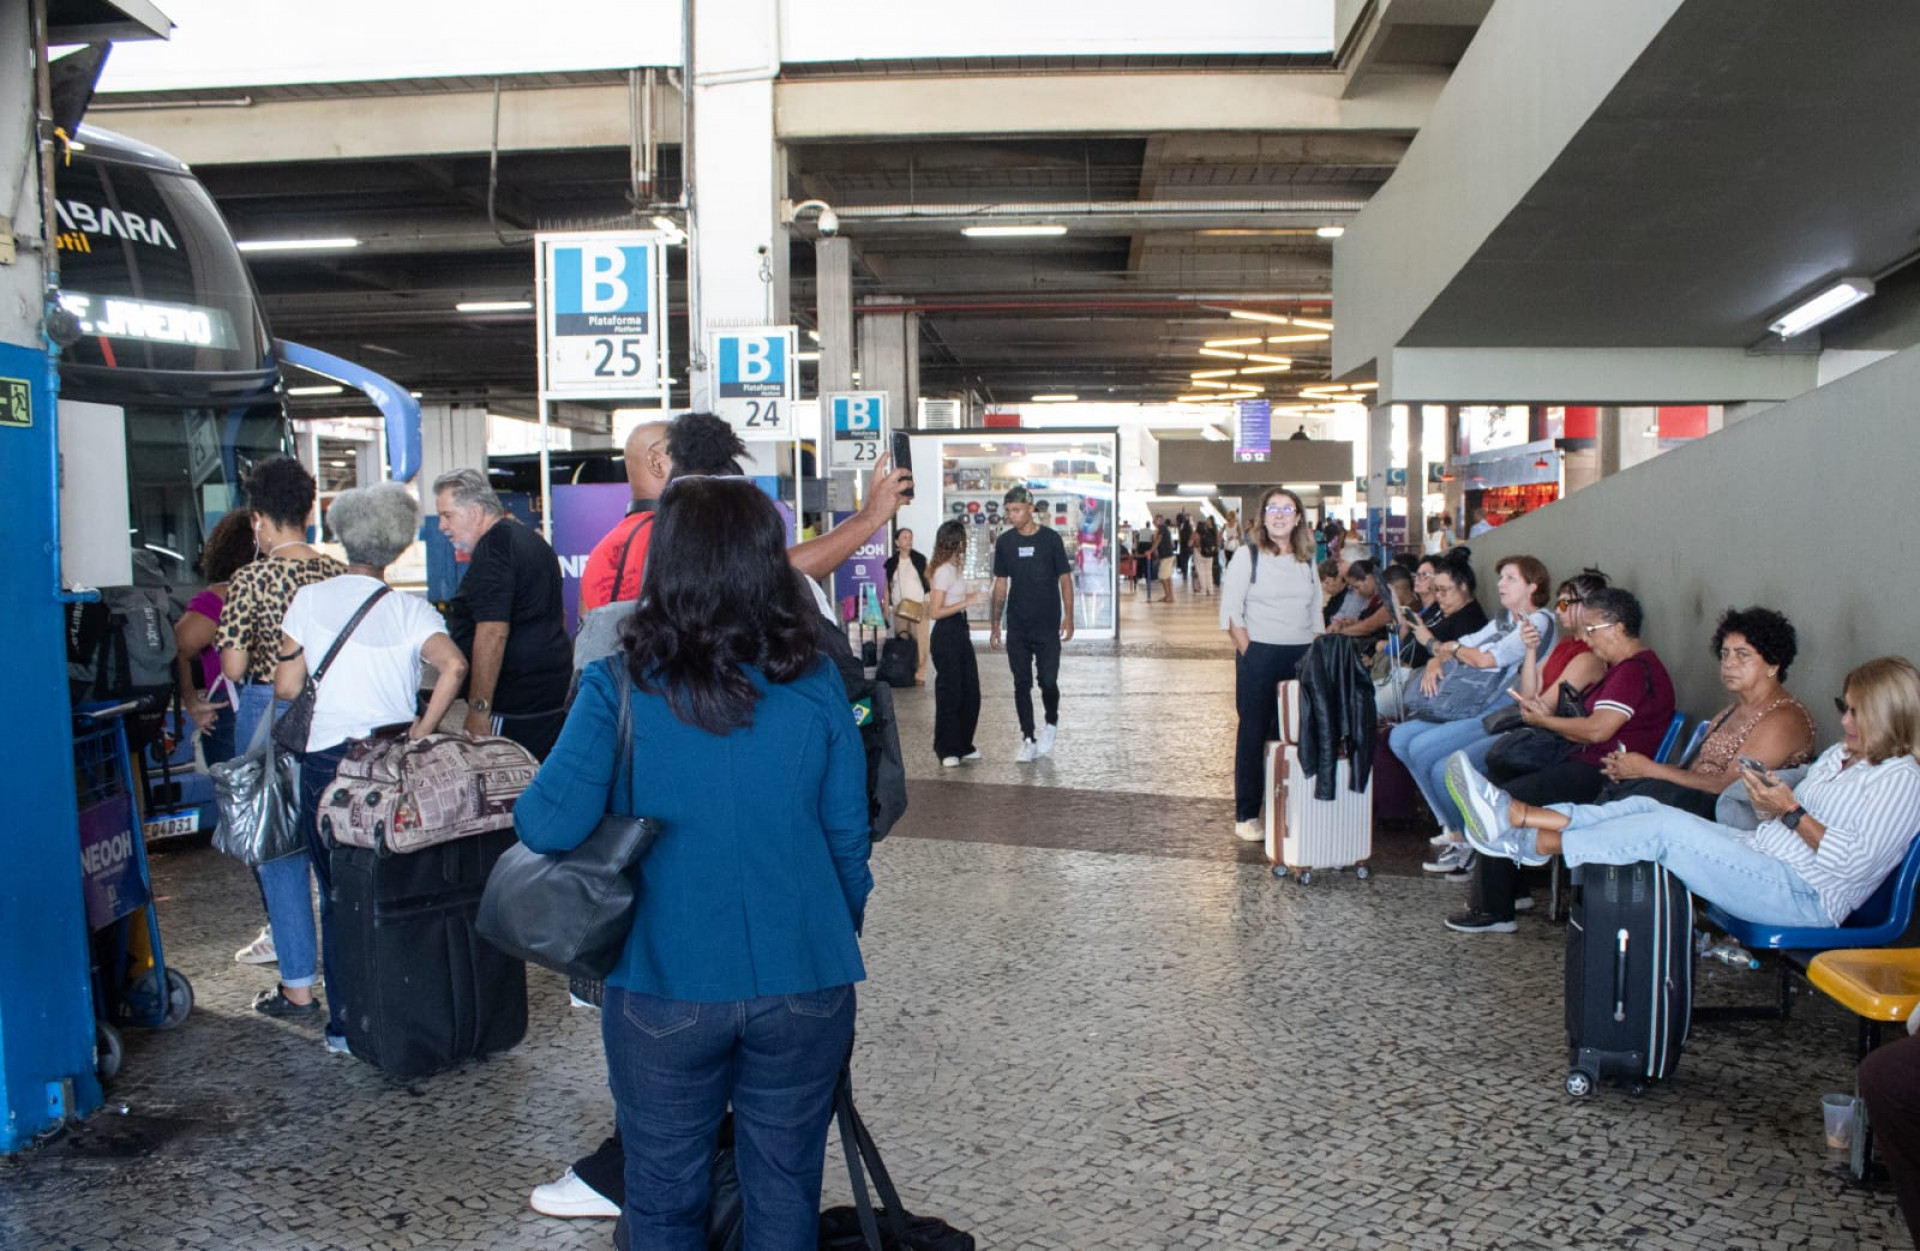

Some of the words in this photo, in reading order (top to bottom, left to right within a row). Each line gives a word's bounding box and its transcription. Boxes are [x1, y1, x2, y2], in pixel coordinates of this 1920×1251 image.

[582, 247, 629, 313] B
[588, 314, 642, 327] Plataforma
[594, 338, 642, 377] 25
[738, 337, 772, 382] B
[746, 400, 780, 427] 24
[847, 398, 871, 430] B
[853, 442, 877, 461] 23
[1391, 469, 1404, 482] C
[82, 829, 133, 874] NEOOH
